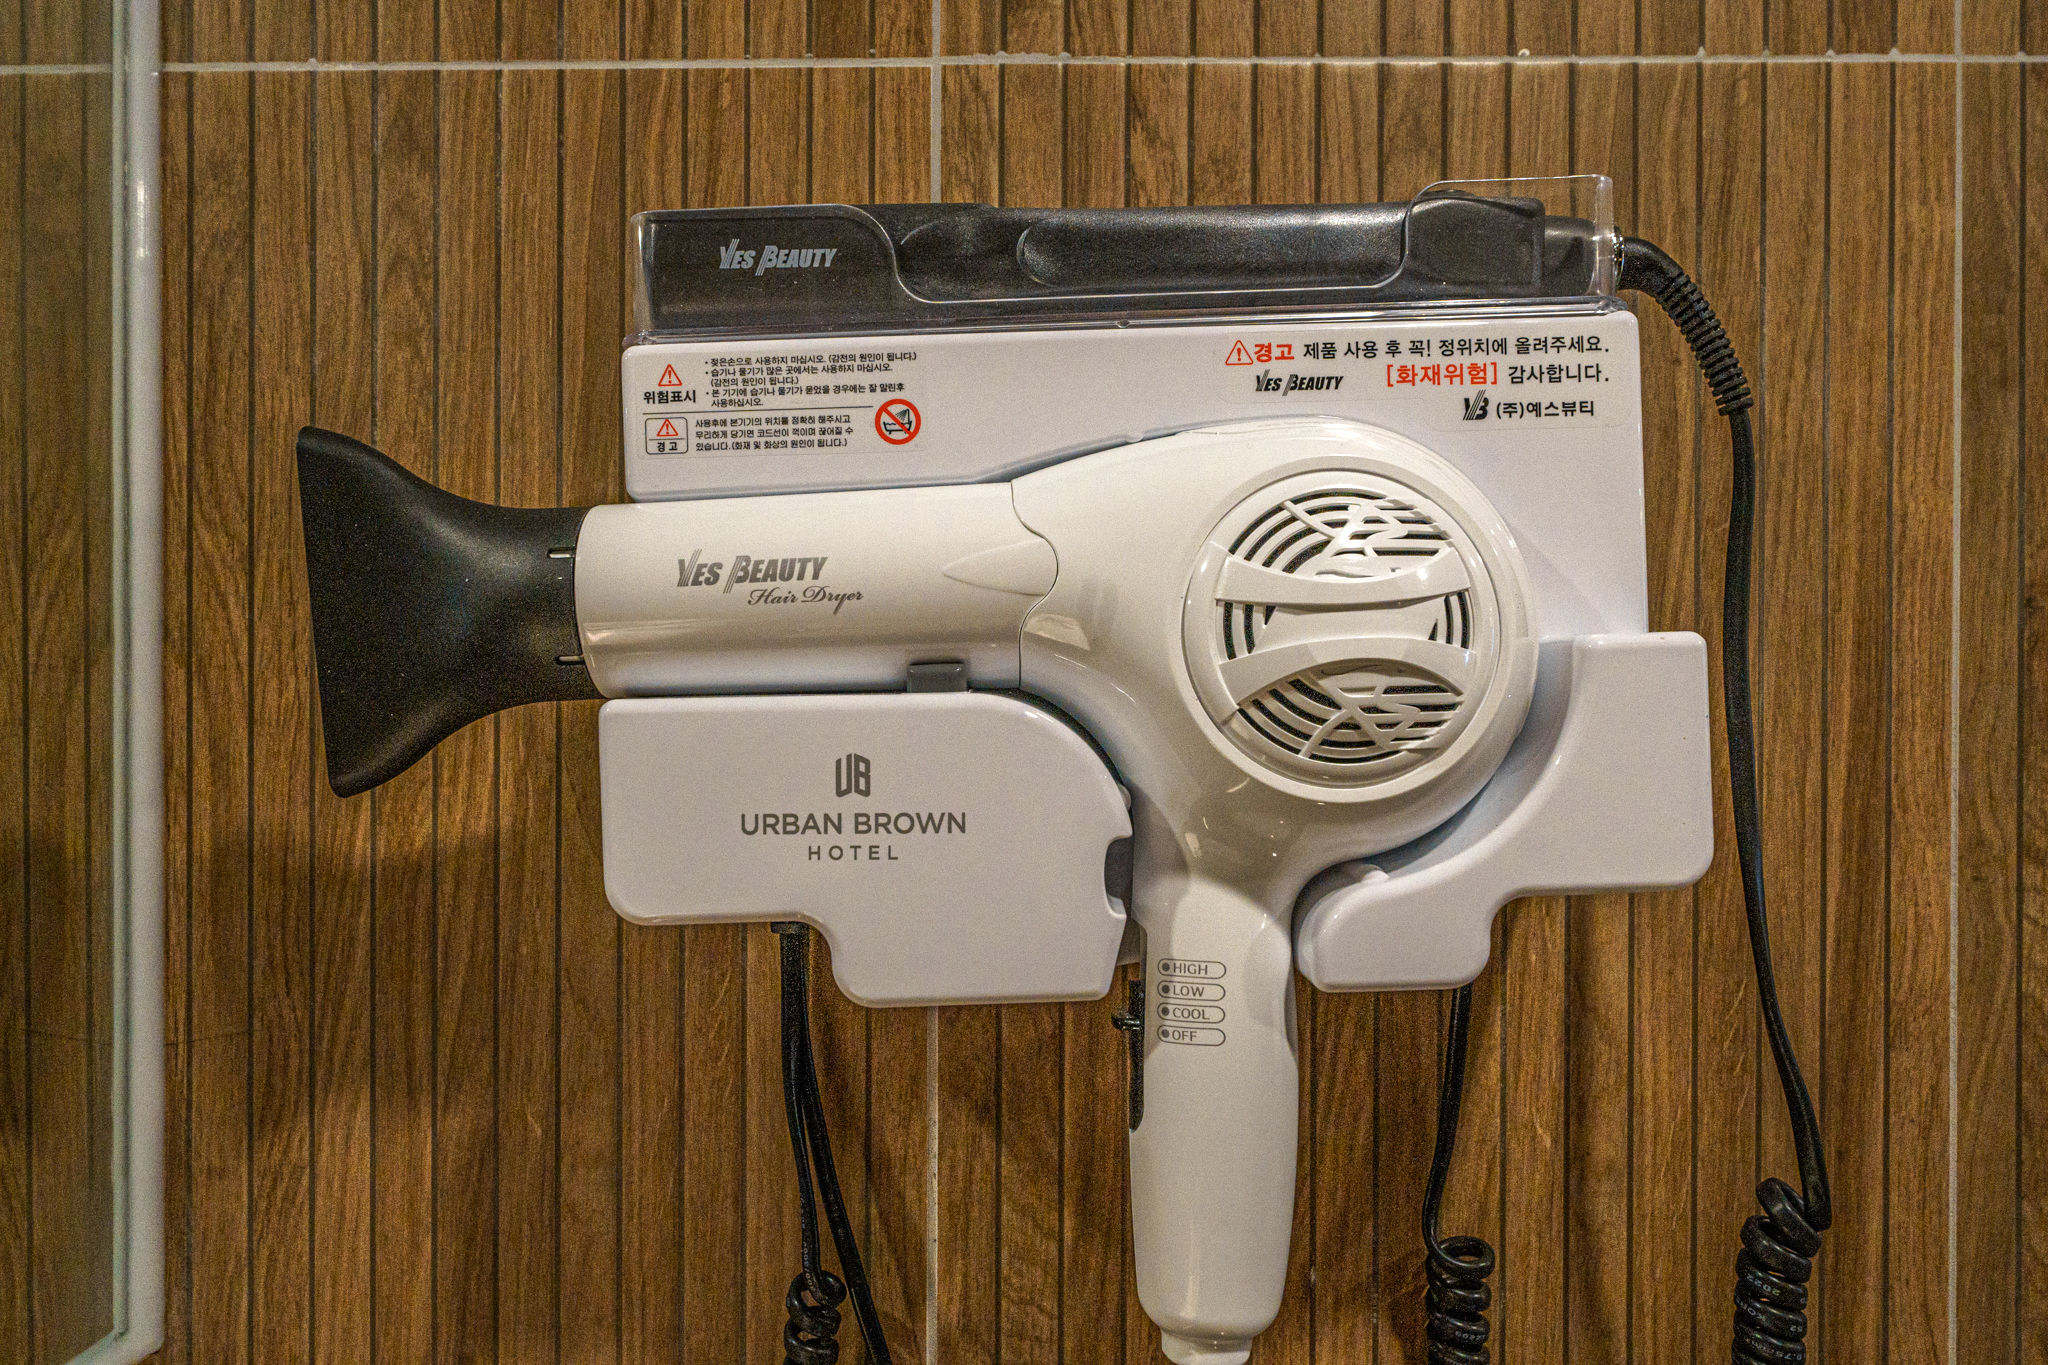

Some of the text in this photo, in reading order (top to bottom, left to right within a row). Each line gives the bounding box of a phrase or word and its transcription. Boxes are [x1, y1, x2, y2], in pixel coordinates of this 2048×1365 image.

[720, 238, 838, 276] YES BEAUTY
[1254, 335, 1609, 363] 경고 제품 사용 후 꼭! 정위치에 올려주세요.
[711, 357, 752, 367] 젖은손으로
[755, 356, 788, 365] 사용하지
[791, 354, 826, 364] 마십시오.
[859, 352, 884, 362] 원인이
[711, 368, 736, 377] 습기나
[766, 366, 783, 375] 많은
[785, 365, 819, 375] 곳에서는
[821, 363, 854, 373] 사용하지
[857, 363, 893, 372] 마십시오.
[1387, 362, 1609, 387] [화재위험] 감사합니다.
[741, 377, 766, 386] 원인이
[1255, 369, 1344, 397] YES BEAUTY
[643, 389, 696, 404] 위험표시
[711, 388, 720, 397] 본
[723, 387, 747, 397] 기기에
[750, 386, 776, 396] 습기나
[833, 384, 866, 394] 경우에는
[868, 383, 877, 392] 잘
[711, 398, 764, 407] 사용하십시오.
[1496, 400, 1595, 419] (주)예스뷰티
[695, 414, 851, 428] 사용후에 본기기의 위치를 정확히 해주시고
[730, 429, 754, 439] 당기면
[757, 428, 789, 438] 코드선이
[845, 426, 854, 435] 수
[753, 440, 761, 450] 및
[764, 440, 788, 449] 화상의
[791, 439, 815, 449] 원인이
[677, 549, 828, 594] YES BEAUTY
[748, 585, 863, 615] Hair Dryer
[835, 752, 871, 798] UB
[741, 812, 966, 836] URBAN BROWN
[808, 845, 898, 861] HOTEL
[1173, 962, 1208, 975] HIGH
[1173, 984, 1204, 997] LOW
[1172, 1007, 1210, 1020] COOL
[1171, 1029, 1197, 1042] OFF
